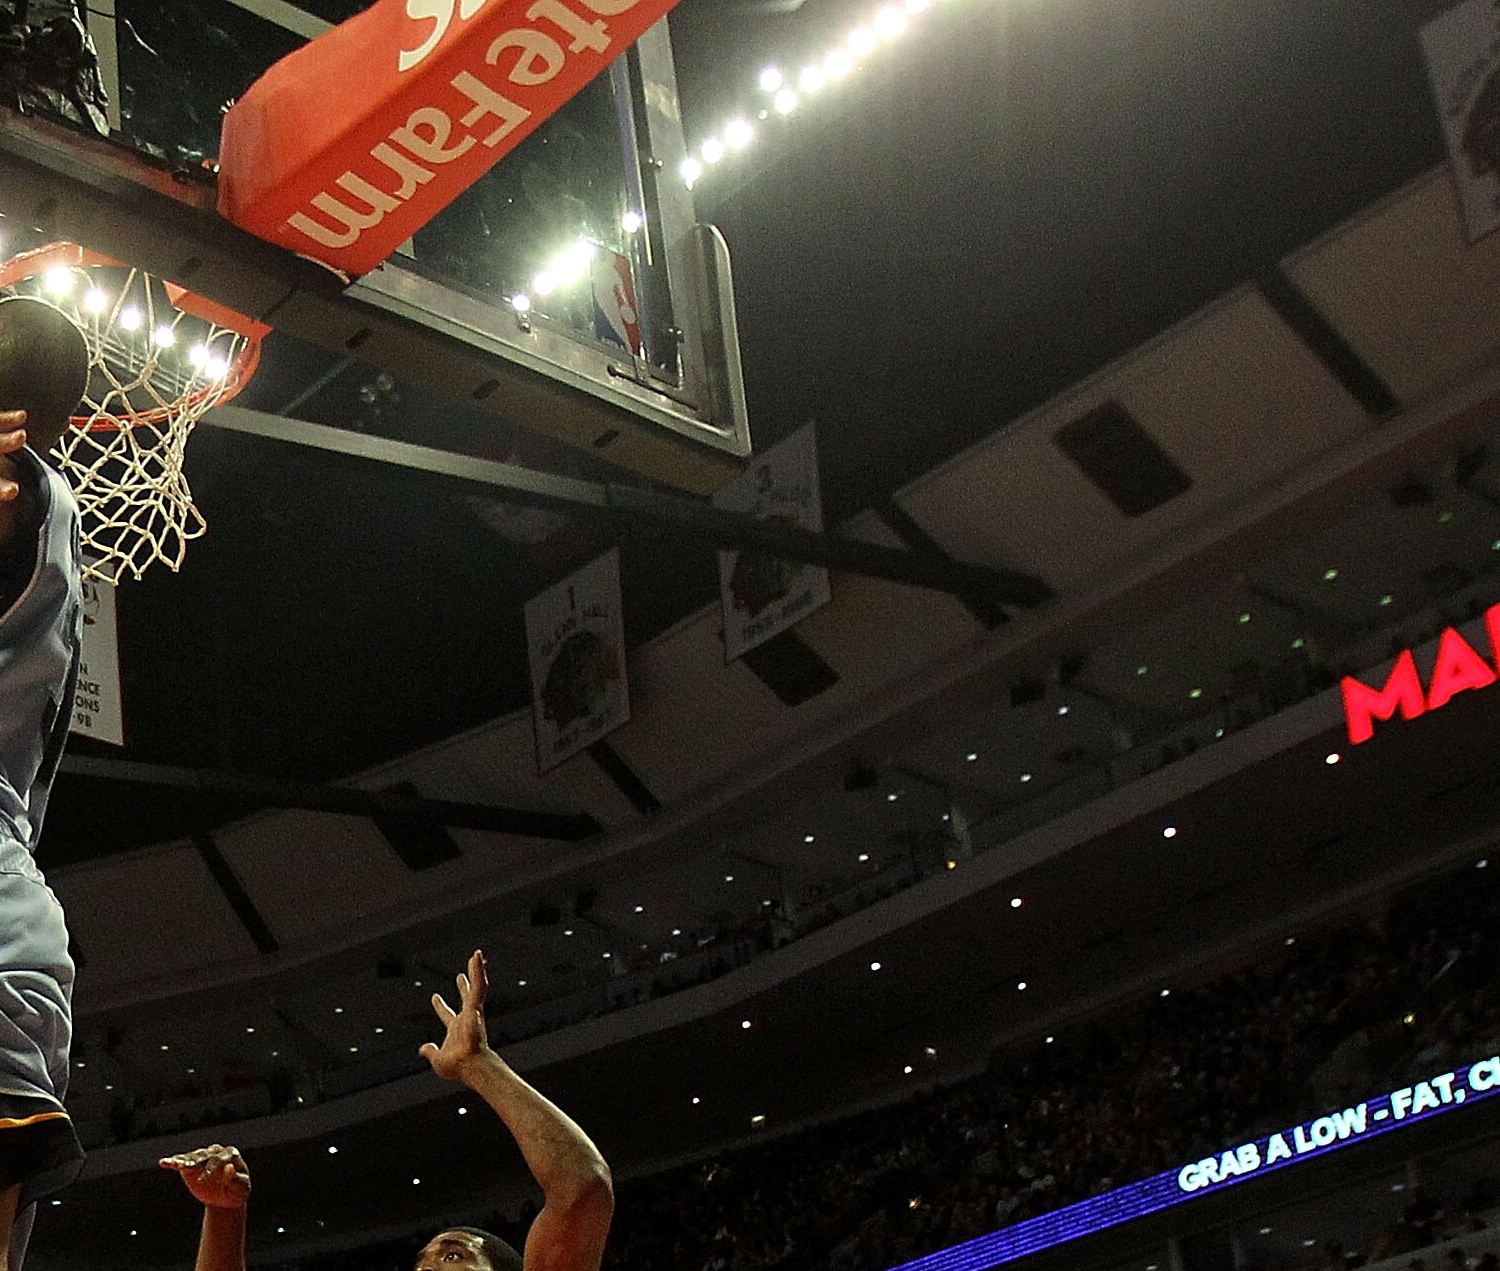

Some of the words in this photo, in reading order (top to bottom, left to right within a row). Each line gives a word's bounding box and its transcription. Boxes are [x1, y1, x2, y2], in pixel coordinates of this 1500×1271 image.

[1178, 1142, 1261, 1192] GRAB
[1266, 1133, 1292, 1164] A
[1293, 1103, 1367, 1154] LOW
